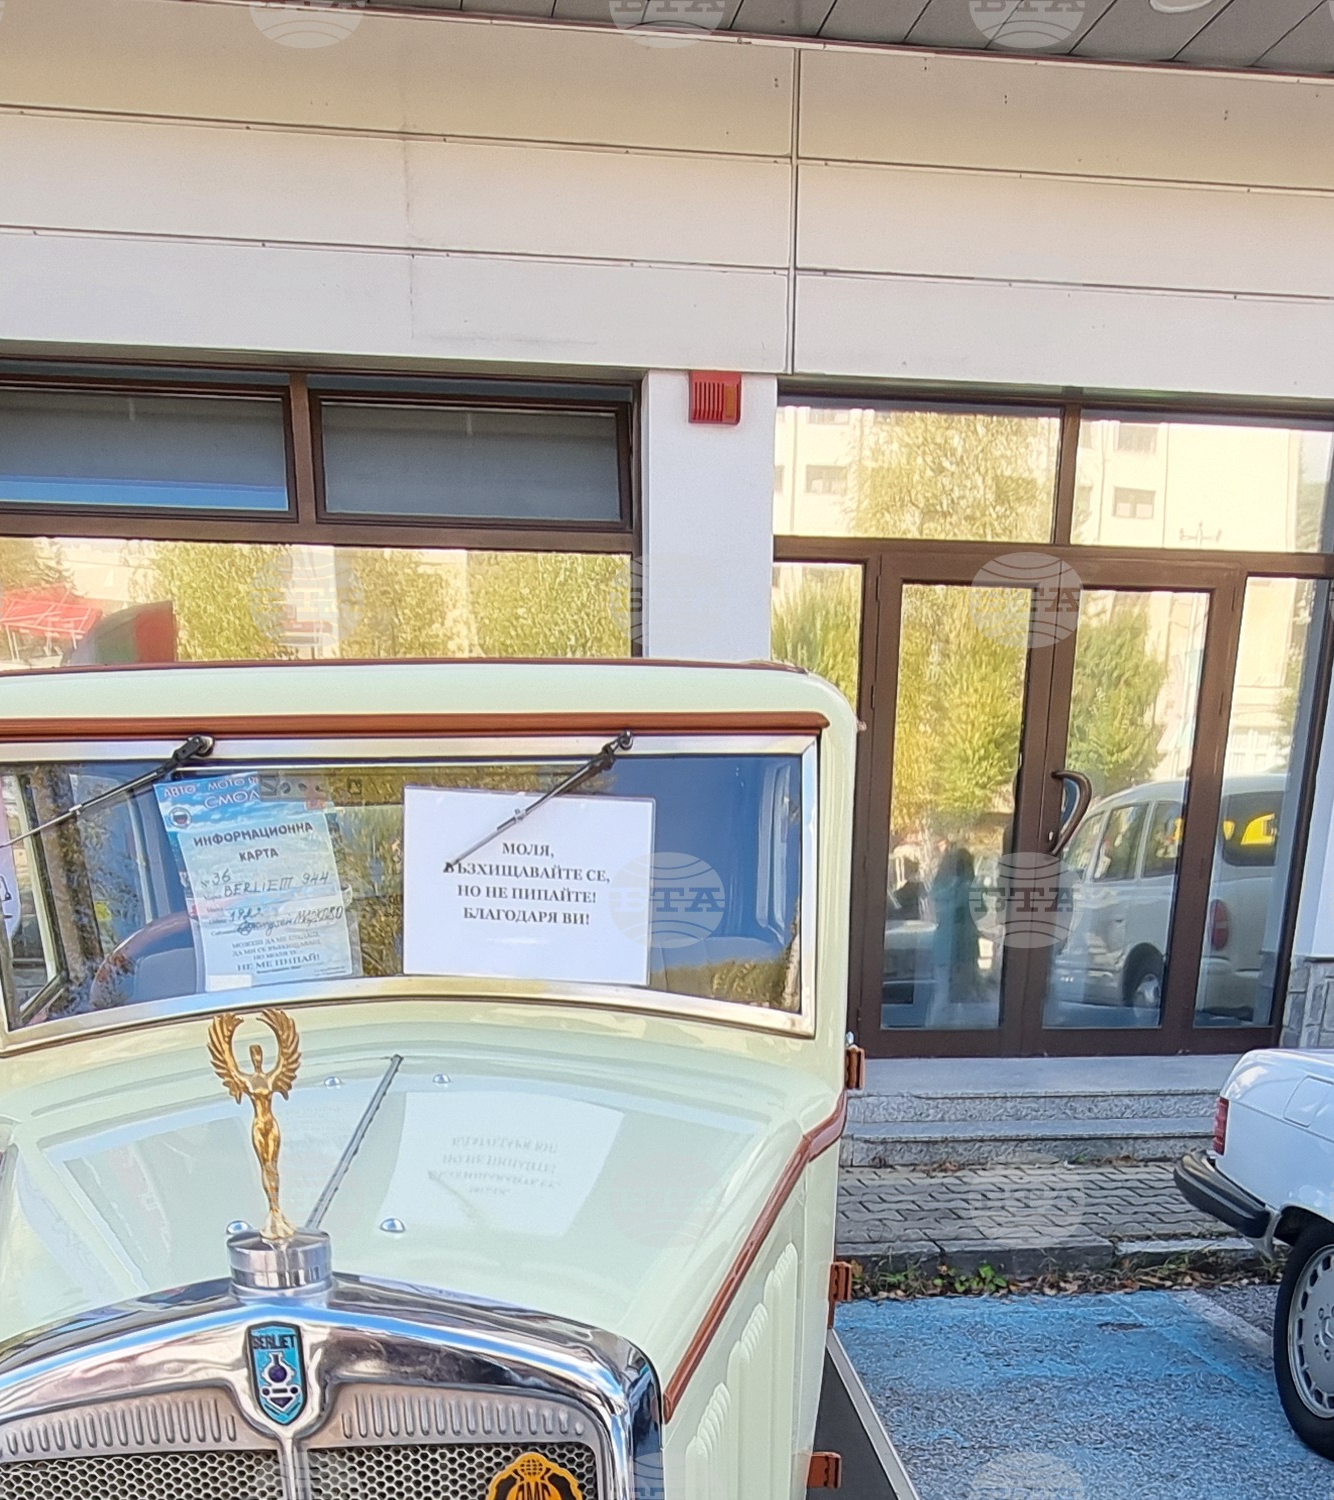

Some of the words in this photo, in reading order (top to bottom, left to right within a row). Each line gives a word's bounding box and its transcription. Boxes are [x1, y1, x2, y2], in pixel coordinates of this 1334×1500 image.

[193, 821, 313, 848] ИНФОРМАЦИОННА
[239, 847, 279, 862] КАРТА
[502, 842, 555, 859] МОЛЯ,
[586, 868, 611, 884] СЕ,
[457, 884, 482, 898] НО
[485, 886, 509, 899] НЕ
[511, 887, 597, 904] ПИПАЙТЕ!
[463, 906, 558, 924] БЛАГОДАРЯ
[562, 911, 590, 926] ВИ!
